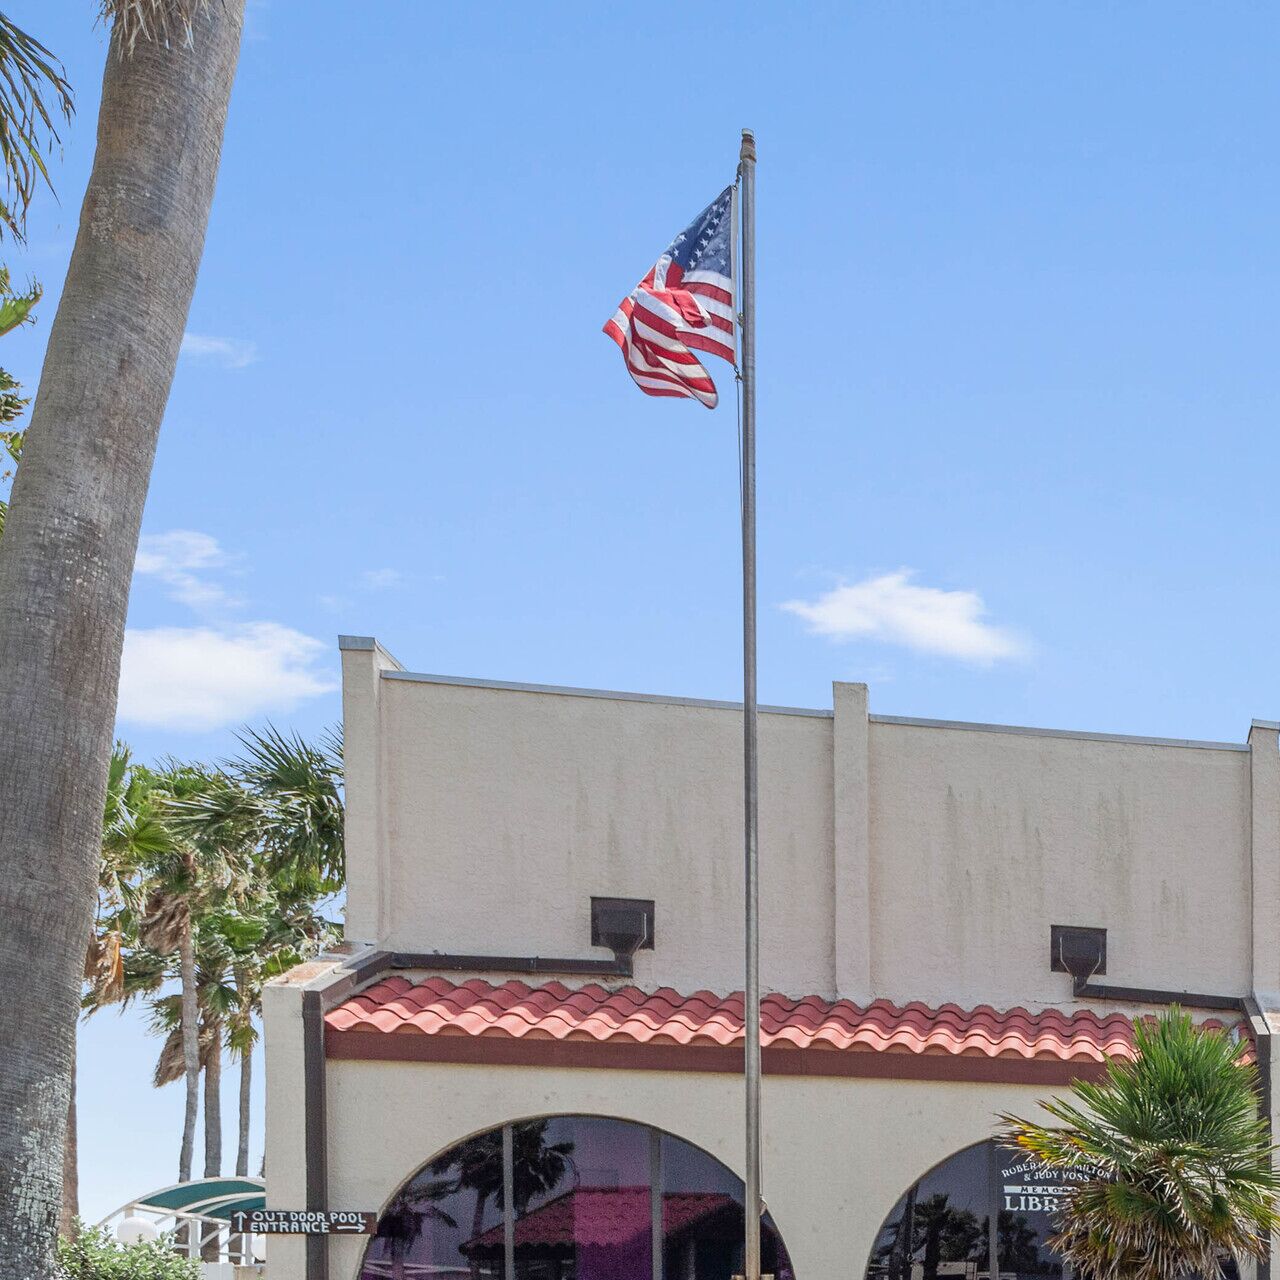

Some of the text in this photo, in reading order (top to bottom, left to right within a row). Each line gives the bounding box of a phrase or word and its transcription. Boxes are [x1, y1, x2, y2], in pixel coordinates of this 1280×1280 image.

[1023, 1171, 1090, 1183] & JUDY VOSS
[1064, 1163, 1111, 1180] MILTON
[330, 1213, 367, 1224] POOL
[250, 1222, 331, 1233] ENTRANCE
